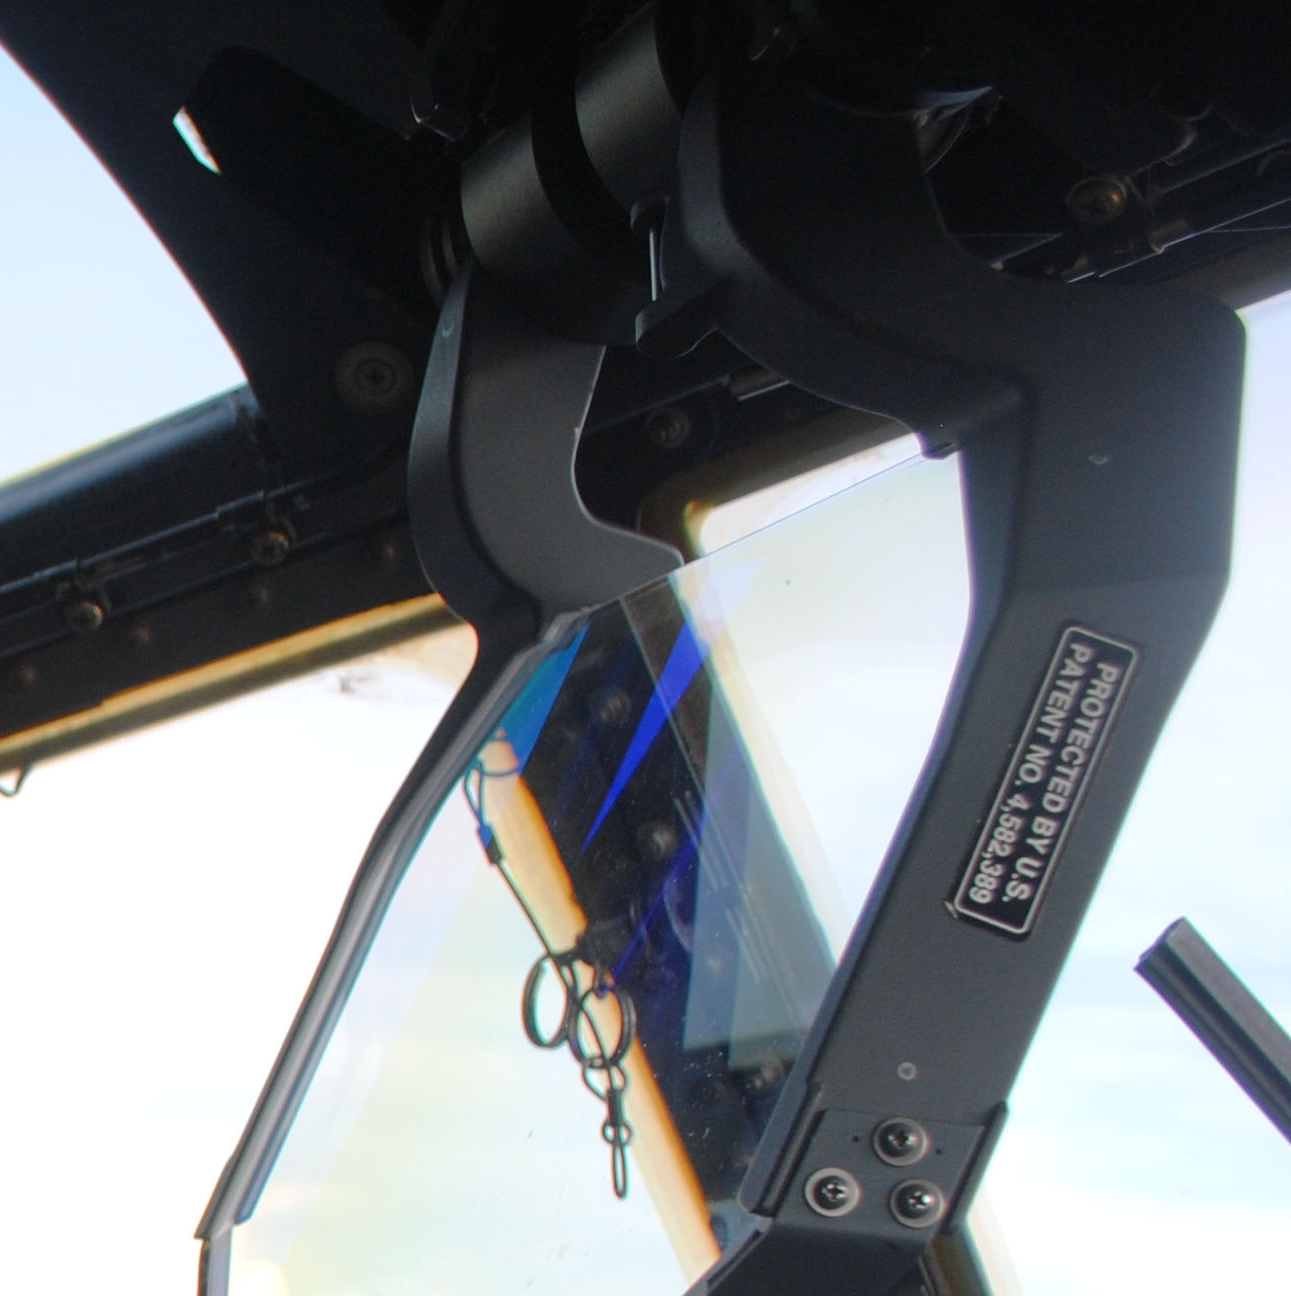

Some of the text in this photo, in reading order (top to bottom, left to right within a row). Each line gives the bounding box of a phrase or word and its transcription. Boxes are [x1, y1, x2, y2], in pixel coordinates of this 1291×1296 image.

[969, 643, 1094, 904] PATENT NO. 4,582,389
[1002, 662, 1120, 902] PROTECTED BY U.S.
